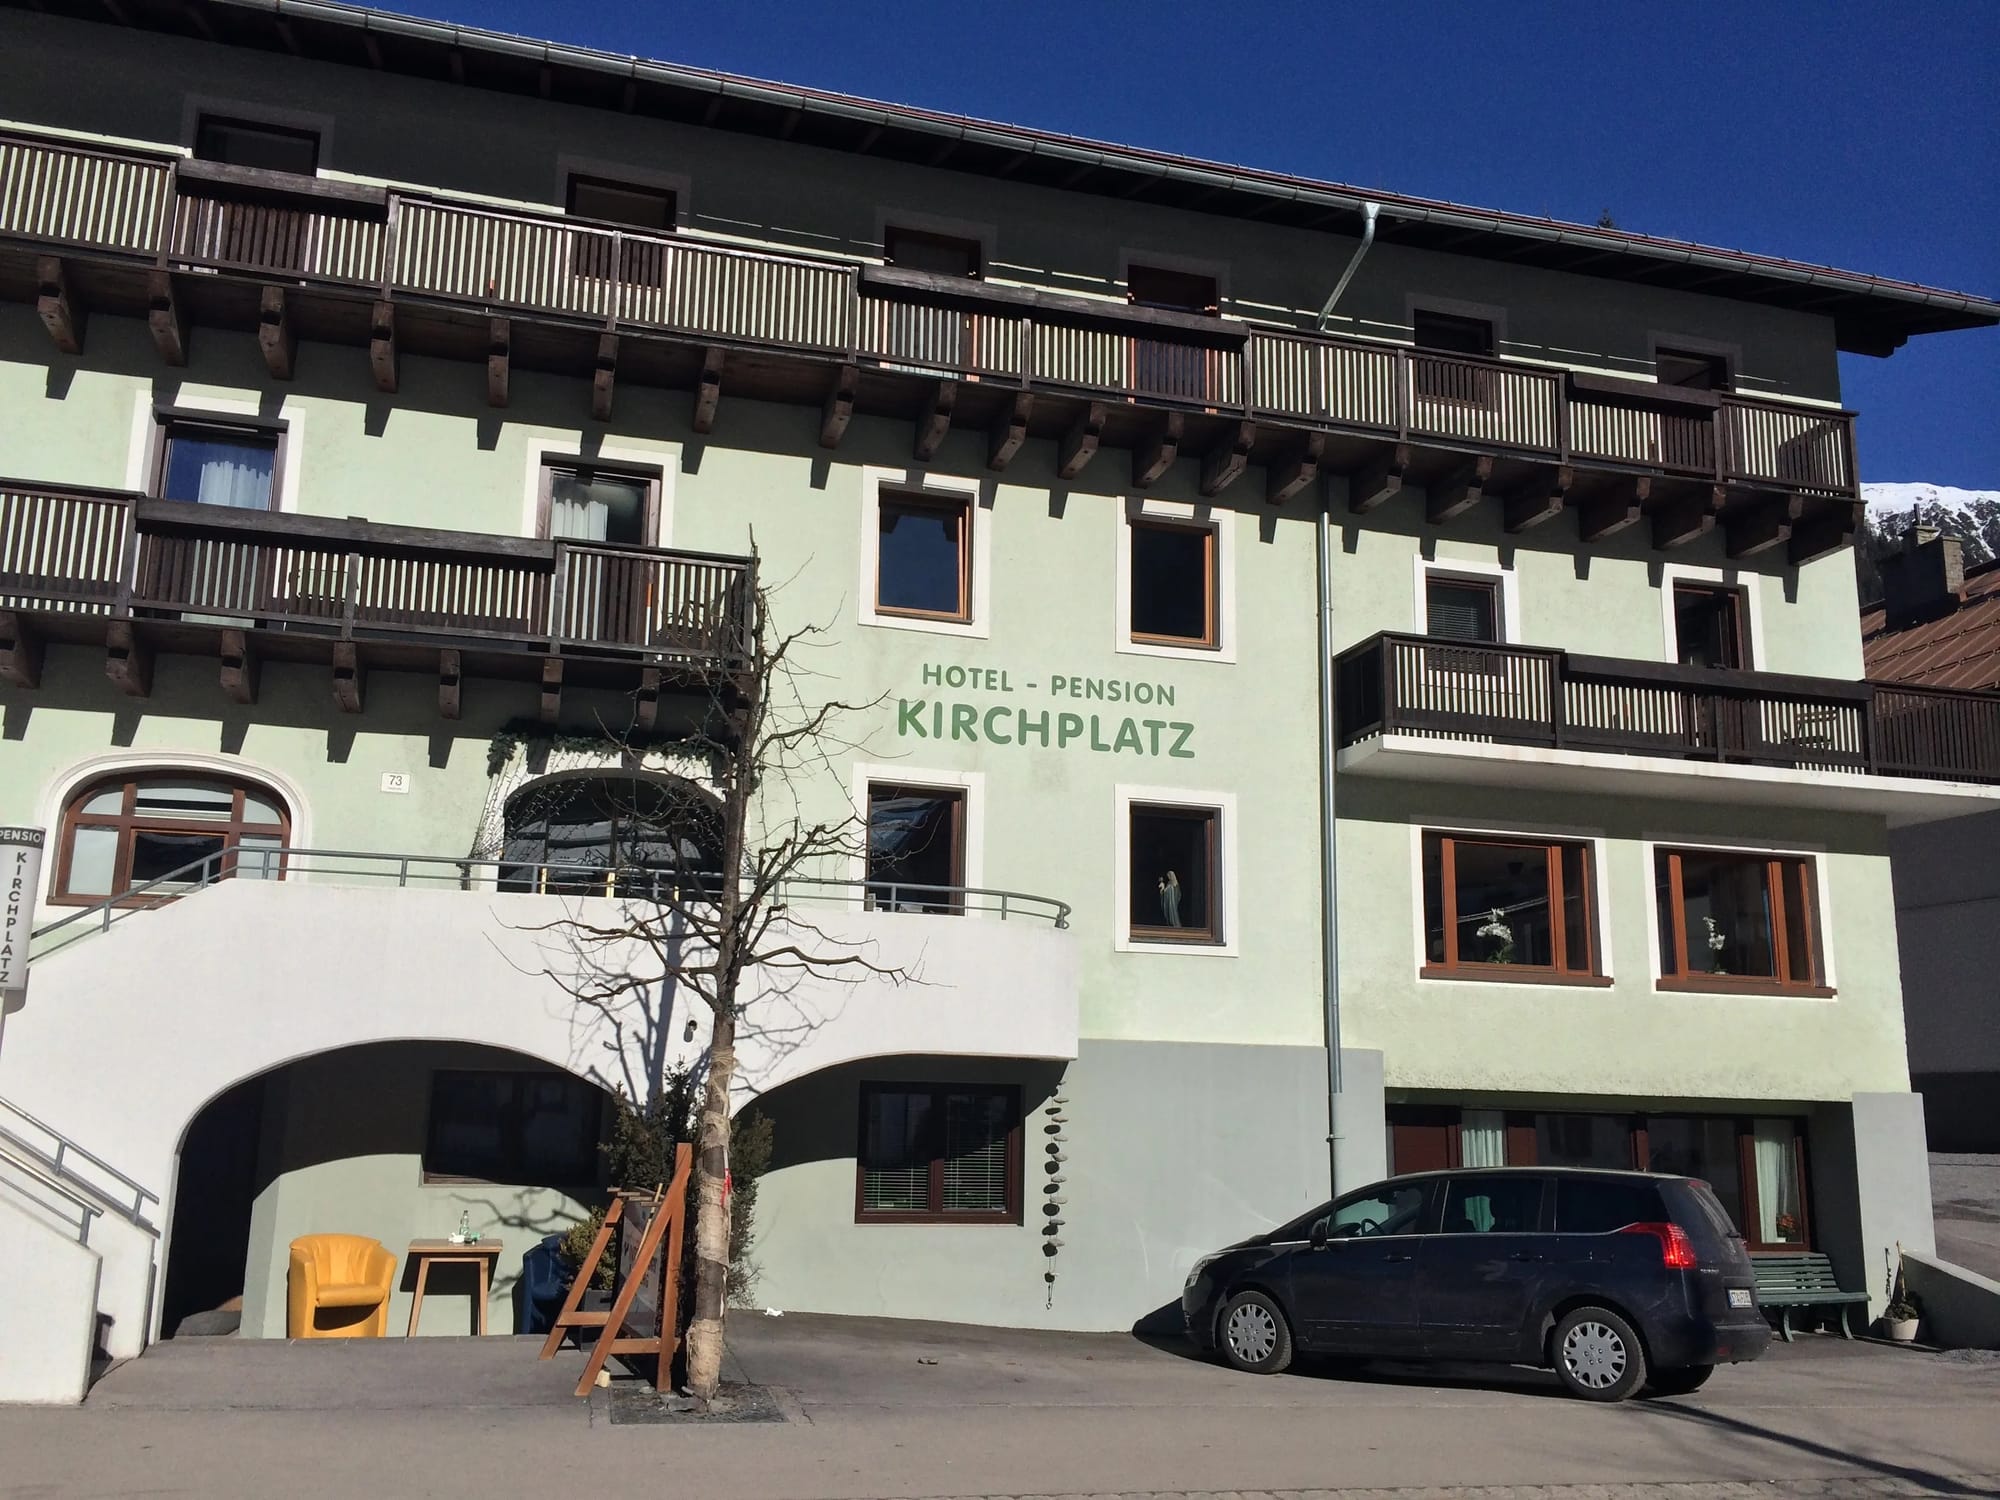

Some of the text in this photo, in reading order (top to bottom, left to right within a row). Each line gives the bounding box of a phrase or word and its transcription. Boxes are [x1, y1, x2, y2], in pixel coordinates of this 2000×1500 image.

[923, 663, 1013, 692] HOTEL
[1051, 675, 1175, 706] PENSION
[898, 698, 1195, 758] KIRCHPLATZ
[389, 774, 402, 786] 73
[0, 829, 44, 843] PENSIO
[0, 852, 27, 983] KIRCHPLATZ
